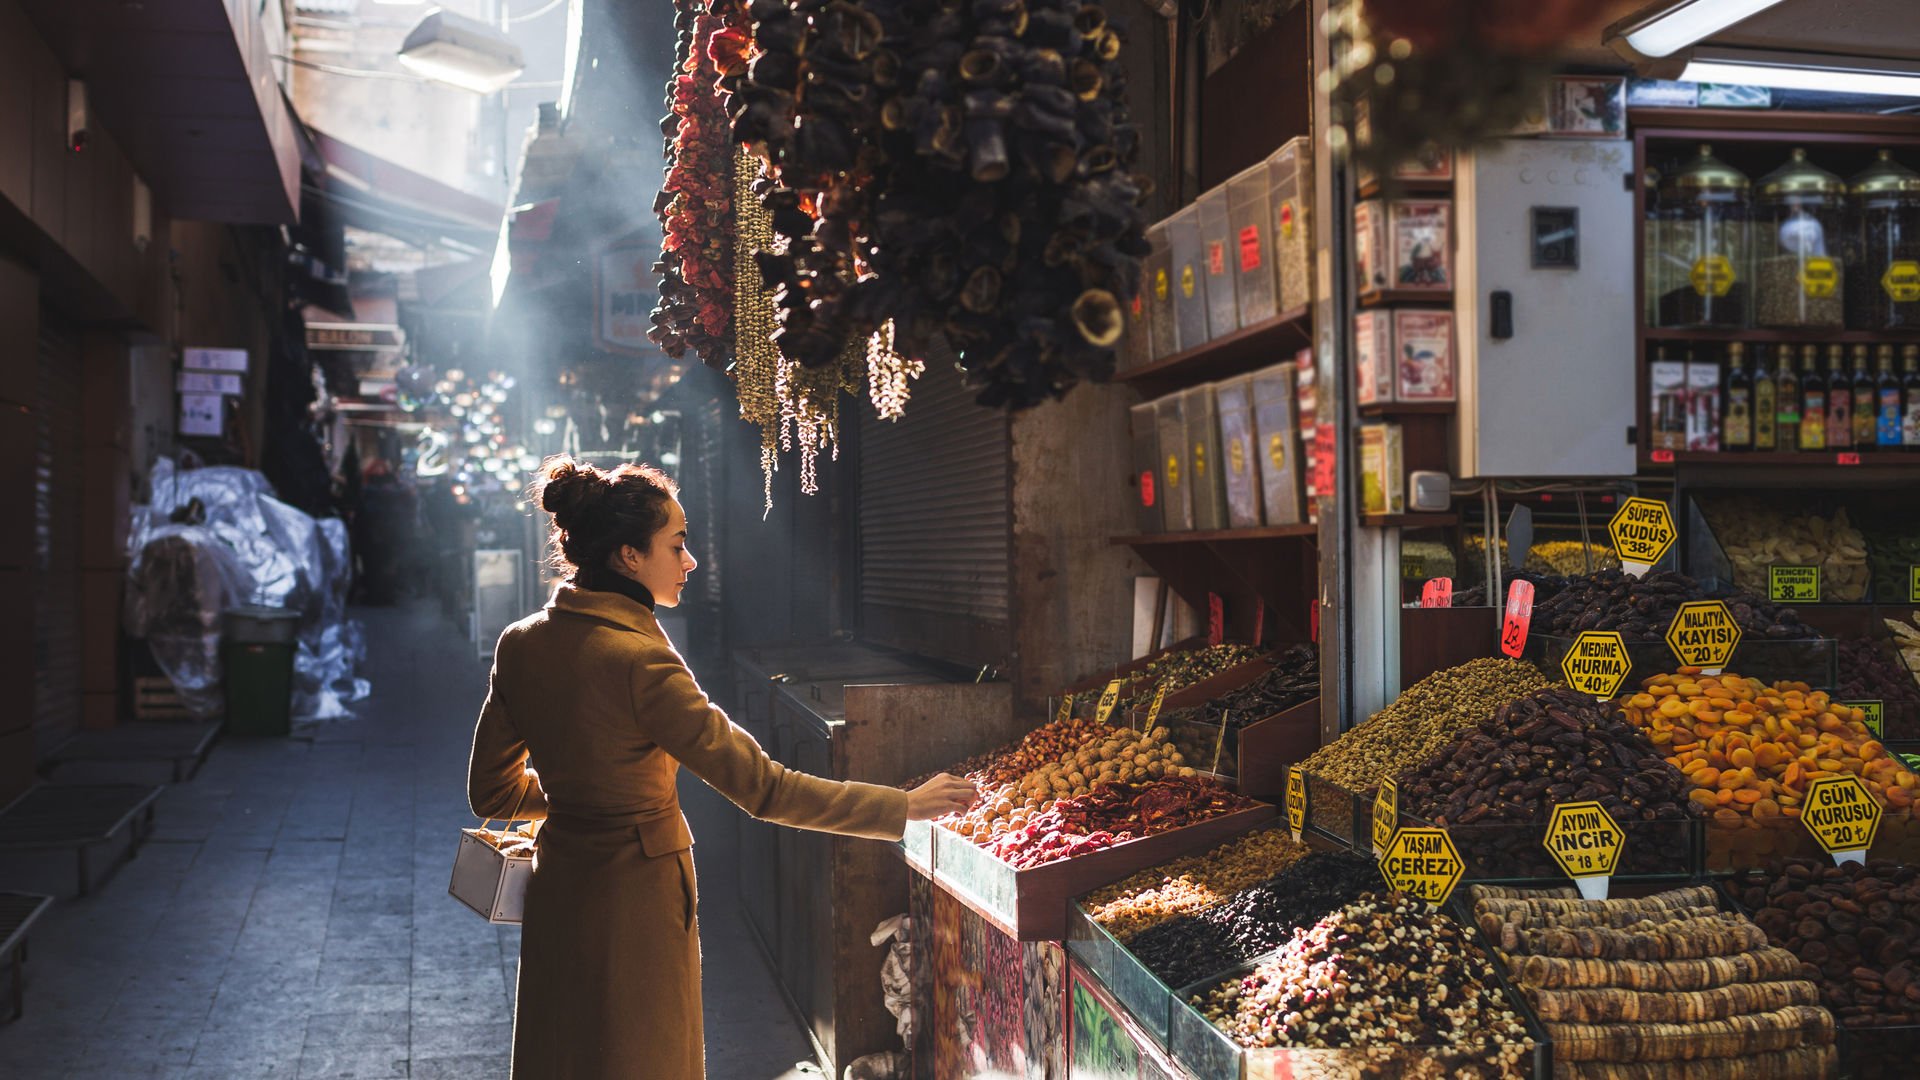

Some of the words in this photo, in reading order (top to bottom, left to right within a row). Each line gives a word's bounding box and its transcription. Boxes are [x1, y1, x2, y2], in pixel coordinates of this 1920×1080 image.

[1627, 504, 1663, 525] SÜPER
[1618, 523, 1668, 543] KUDÜS
[1684, 611, 1725, 628] MALATYA
[1678, 627, 1732, 646] KAYISI
[1683, 647, 1692, 655] KG
[1571, 658, 1621, 676] HURMA
[1819, 784, 1857, 806] GÜN
[1561, 812, 1601, 832] AYDIN
[1811, 803, 1874, 826] KURUSU
[1402, 836, 1442, 858] YAŞAM
[1565, 854, 1575, 862] KG
